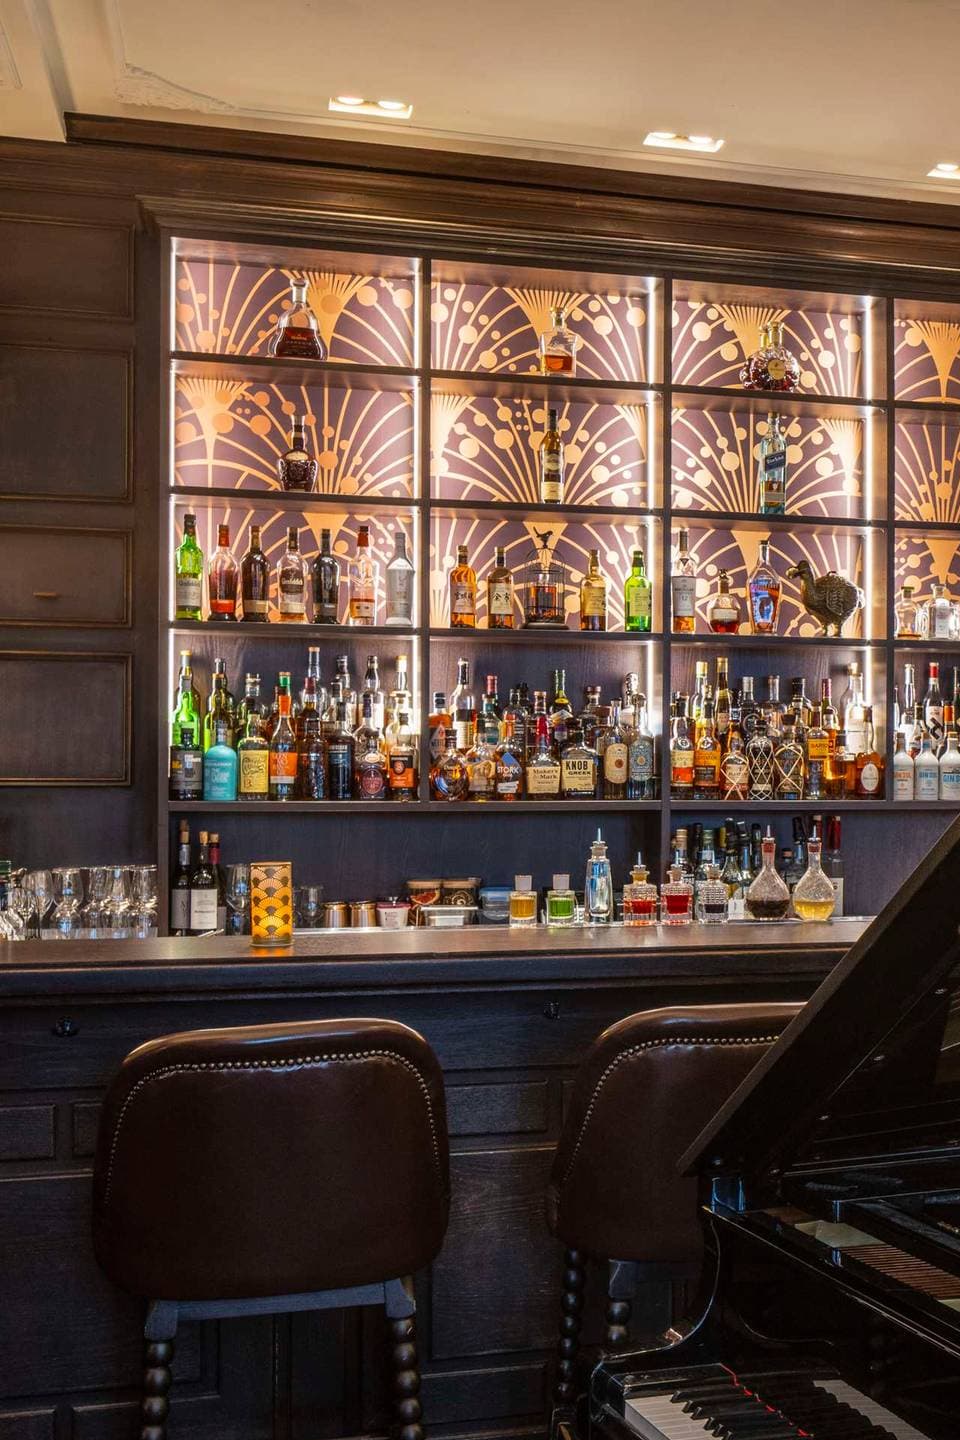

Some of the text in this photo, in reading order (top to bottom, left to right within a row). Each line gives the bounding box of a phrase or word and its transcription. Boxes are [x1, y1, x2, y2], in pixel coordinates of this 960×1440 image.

[565, 760, 588, 770] KNOB
[497, 766, 519, 774] STORK
[943, 774, 955, 783] GIN
